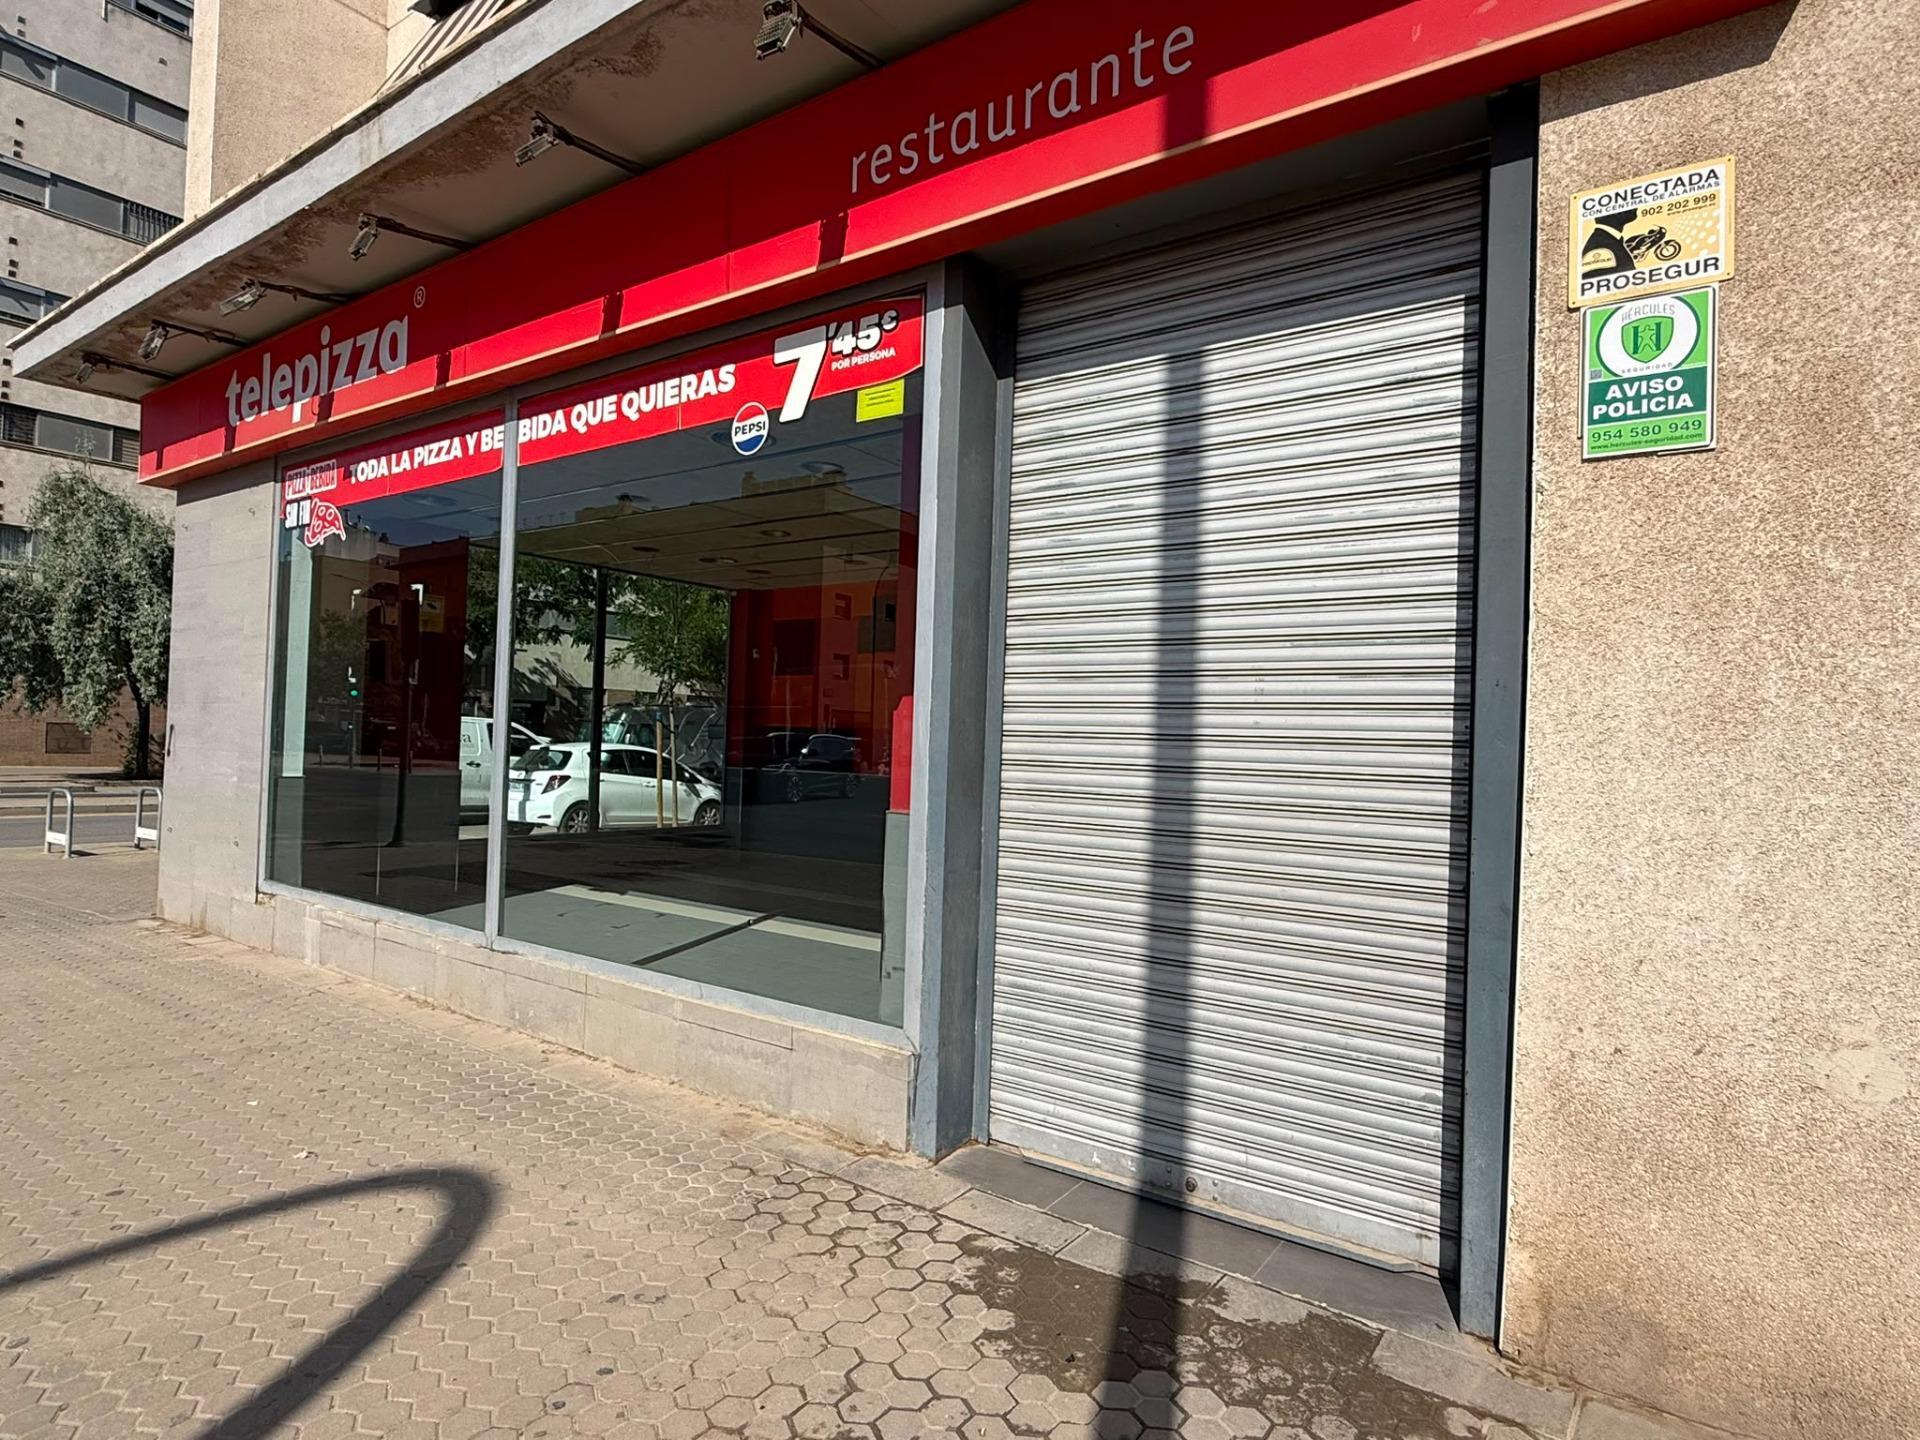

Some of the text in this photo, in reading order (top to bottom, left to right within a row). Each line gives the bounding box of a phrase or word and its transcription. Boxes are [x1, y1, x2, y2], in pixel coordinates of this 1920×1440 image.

[851, 25, 1195, 193] restaurante
[1582, 168, 1720, 212] CONECTADA
[1582, 180, 1721, 218] CON CENTRAL DE ALARMAS
[1641, 193, 1717, 217] 902 202 999
[1580, 256, 1720, 296] PROSEGUR
[225, 315, 409, 428] telepizza
[831, 347, 897, 371] POR PERSONA
[1605, 375, 1684, 401] AVISO
[1592, 392, 1695, 420] POLICIA
[350, 456, 390, 485] TODA
[390, 450, 411, 475] LA
[413, 437, 463, 469] PIZZA
[465, 431, 479, 456] Y
[570, 393, 618, 434] QUE
[620, 363, 736, 422] QUIERAS
[734, 420, 766, 437] PEPSI
[1591, 419, 1703, 443] 954 580 949
